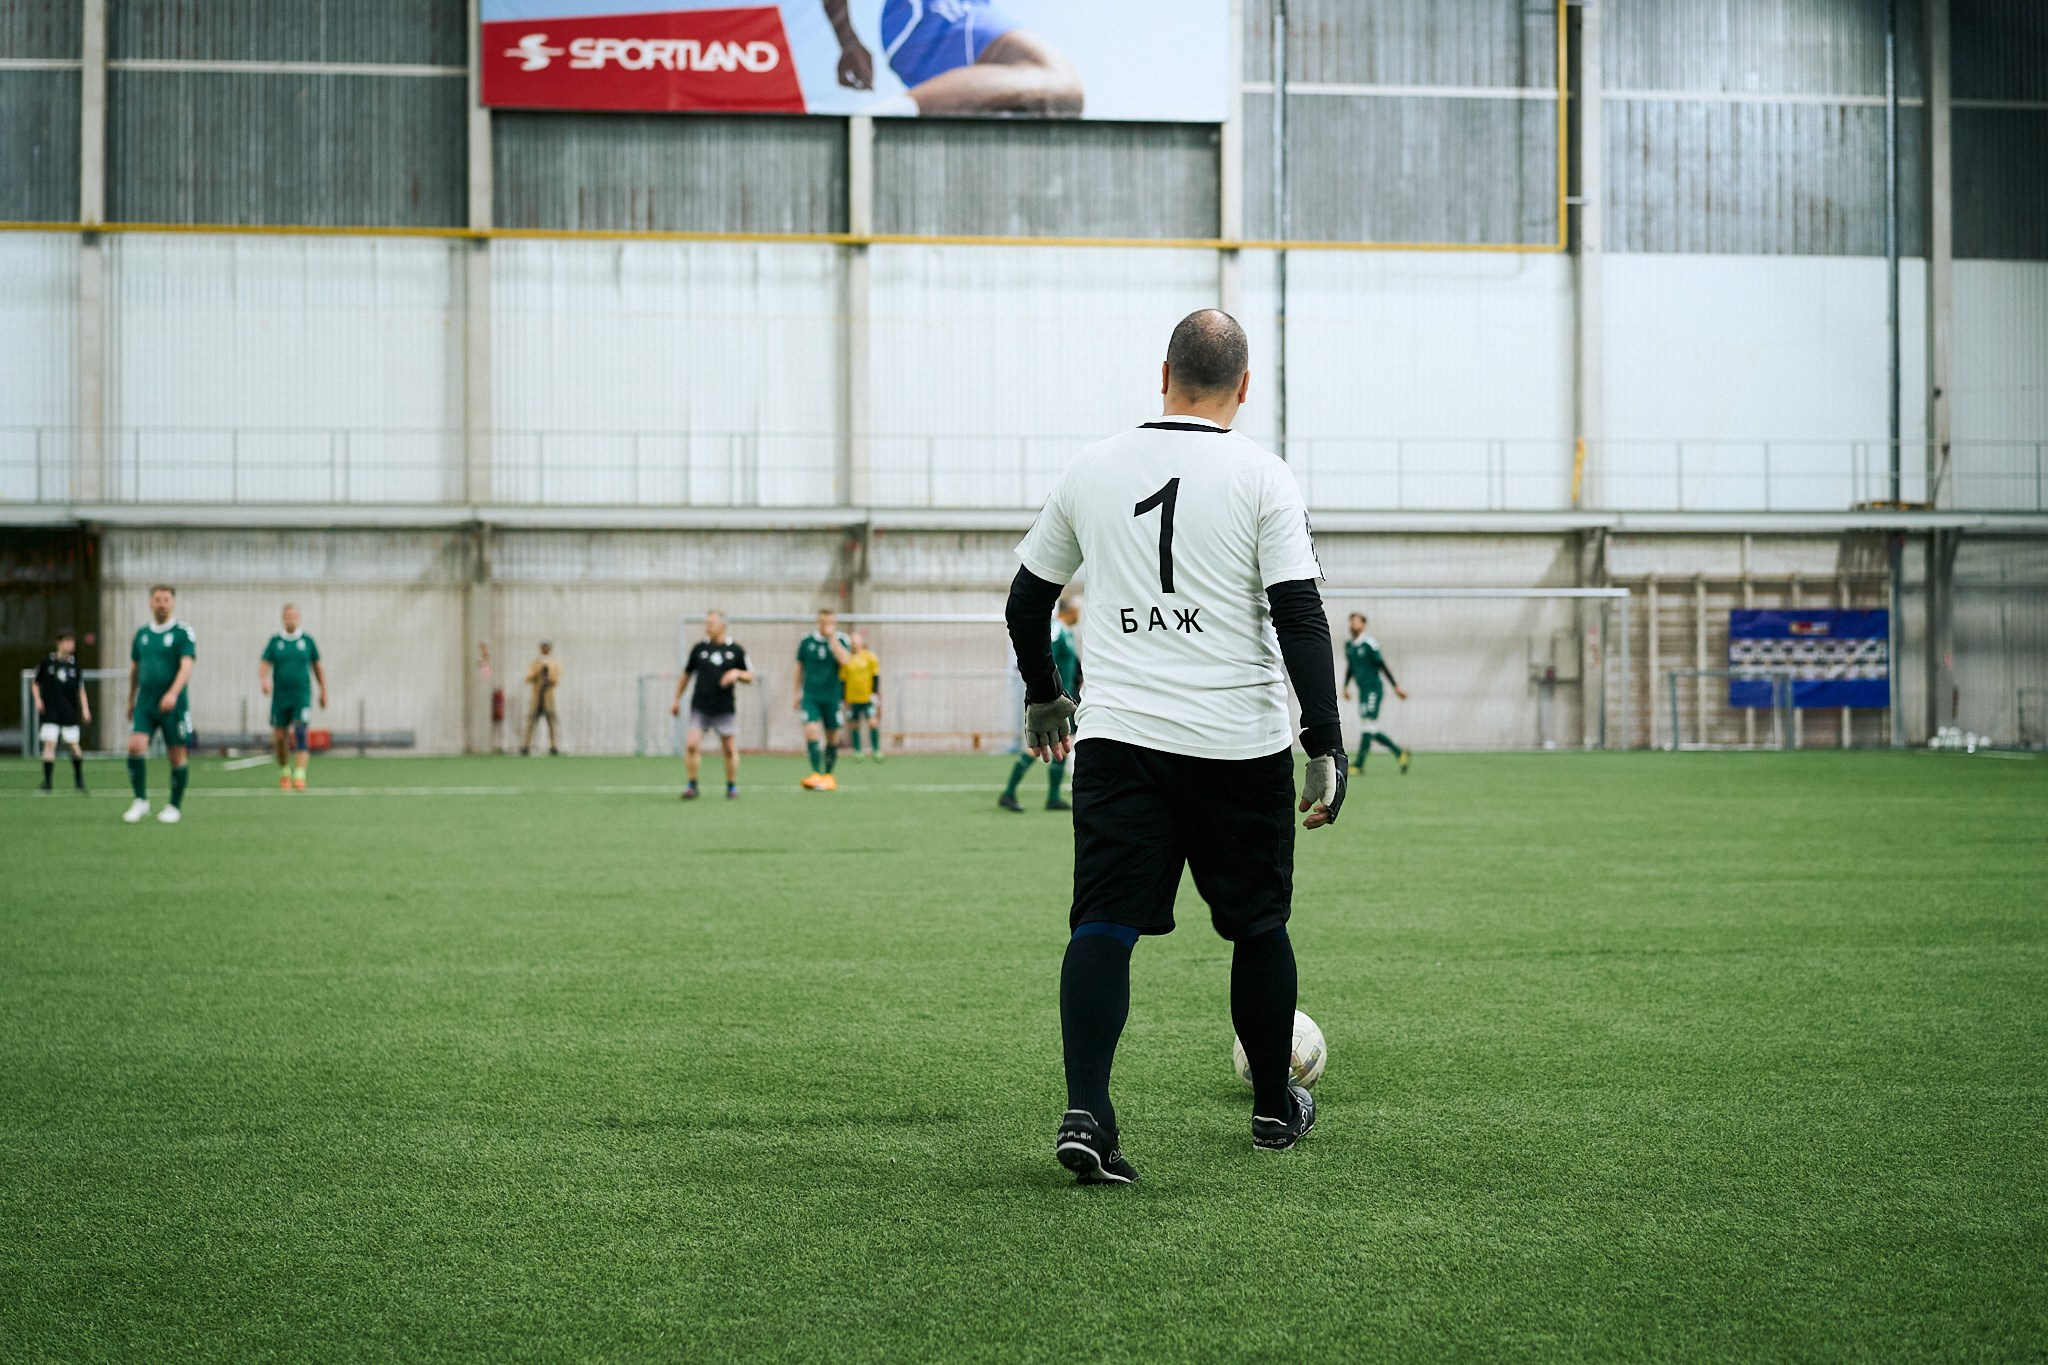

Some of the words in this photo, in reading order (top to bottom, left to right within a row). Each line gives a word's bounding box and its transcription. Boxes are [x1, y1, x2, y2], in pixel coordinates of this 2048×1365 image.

[569, 38, 780, 72] SPORTLAND
[1133, 477, 1181, 593] 1
[1120, 606, 1204, 634] БАЖ
